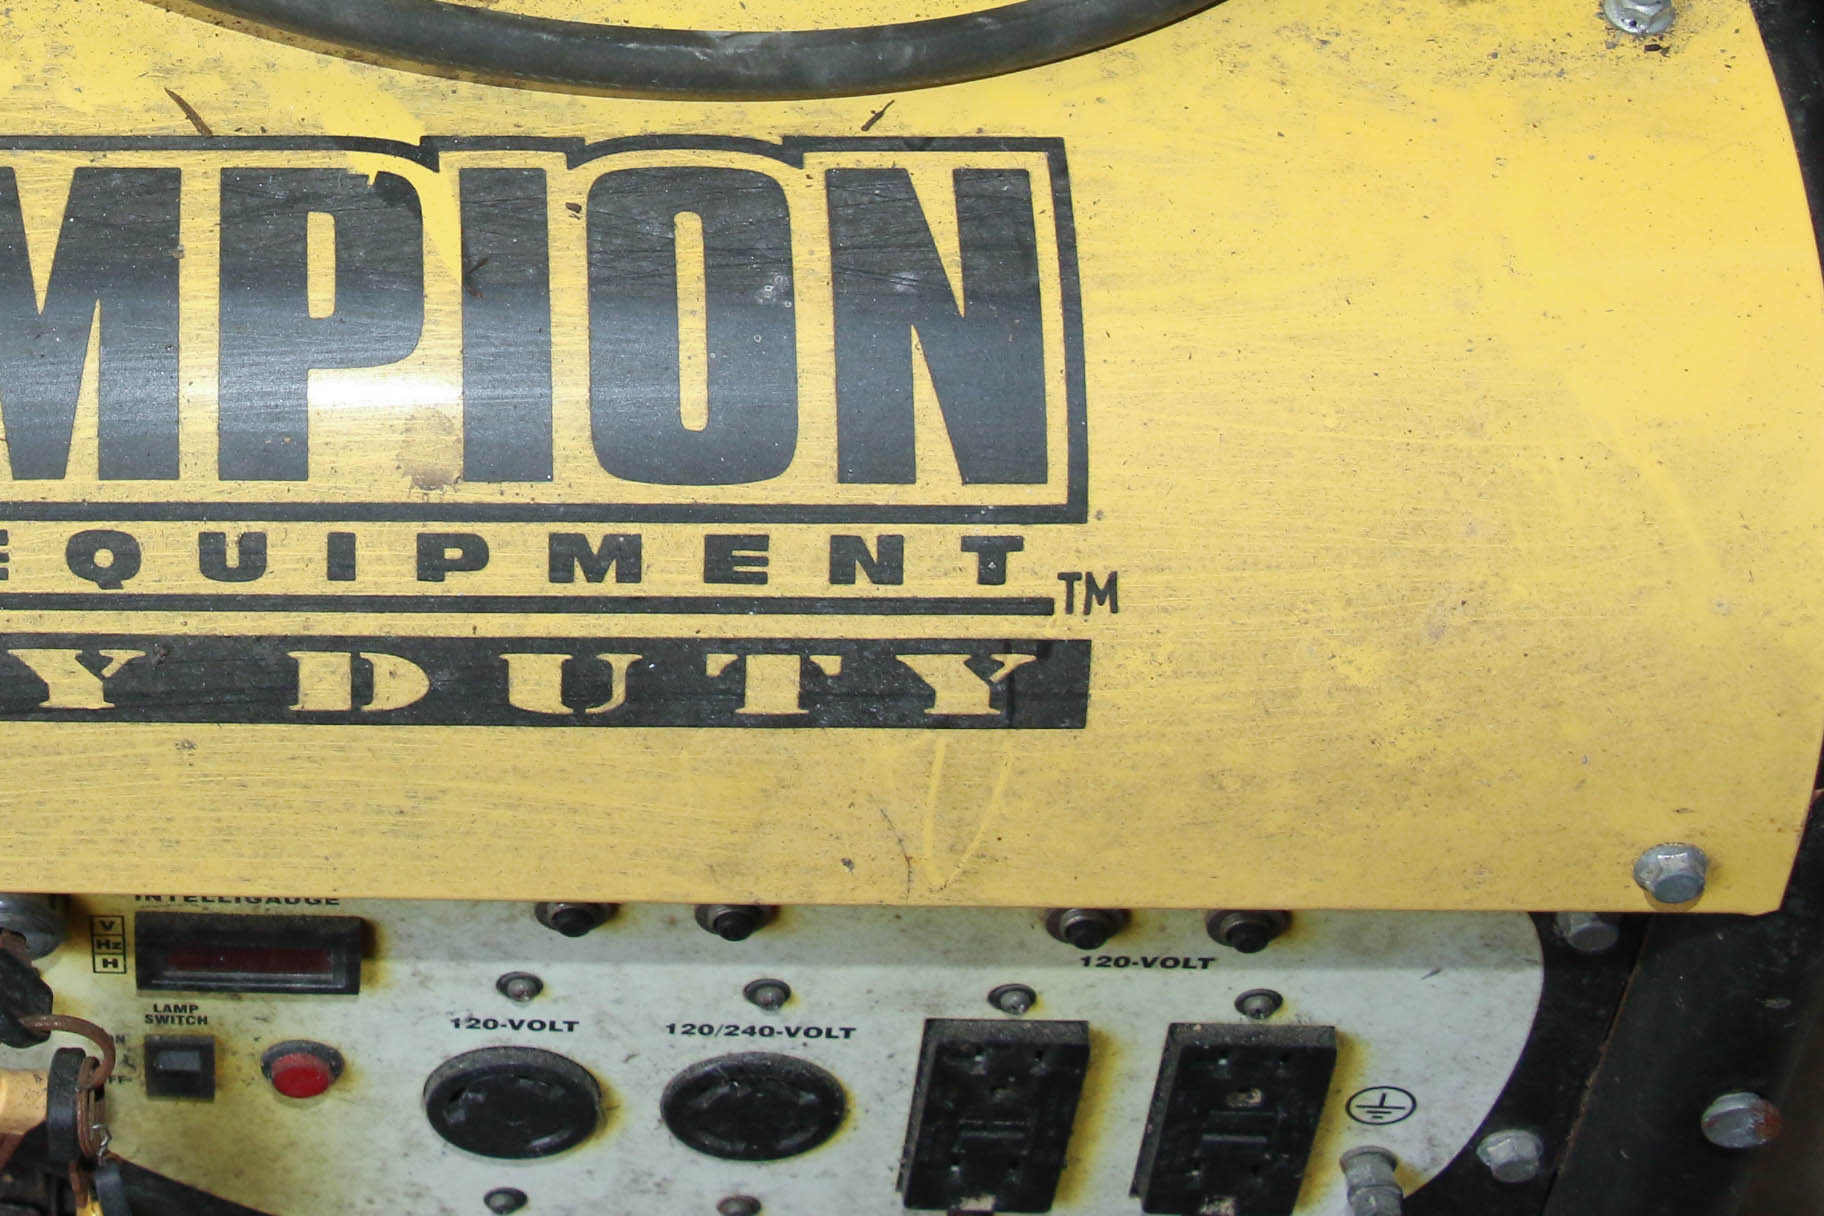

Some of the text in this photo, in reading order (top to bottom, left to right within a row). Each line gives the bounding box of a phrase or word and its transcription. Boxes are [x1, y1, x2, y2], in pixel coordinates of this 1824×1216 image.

[1050, 572, 1117, 617] TM
[282, 650, 1038, 717] DUTY
[98, 920, 115, 931] V
[95, 939, 122, 950] Hz
[101, 958, 118, 968] H
[1080, 955, 1217, 971] 120-VOLT
[152, 1003, 200, 1015] LAMP
[143, 1013, 209, 1026] SWITCH
[449, 1018, 580, 1033] 120-VOLT
[664, 1023, 858, 1041] 120/240-VOLT
